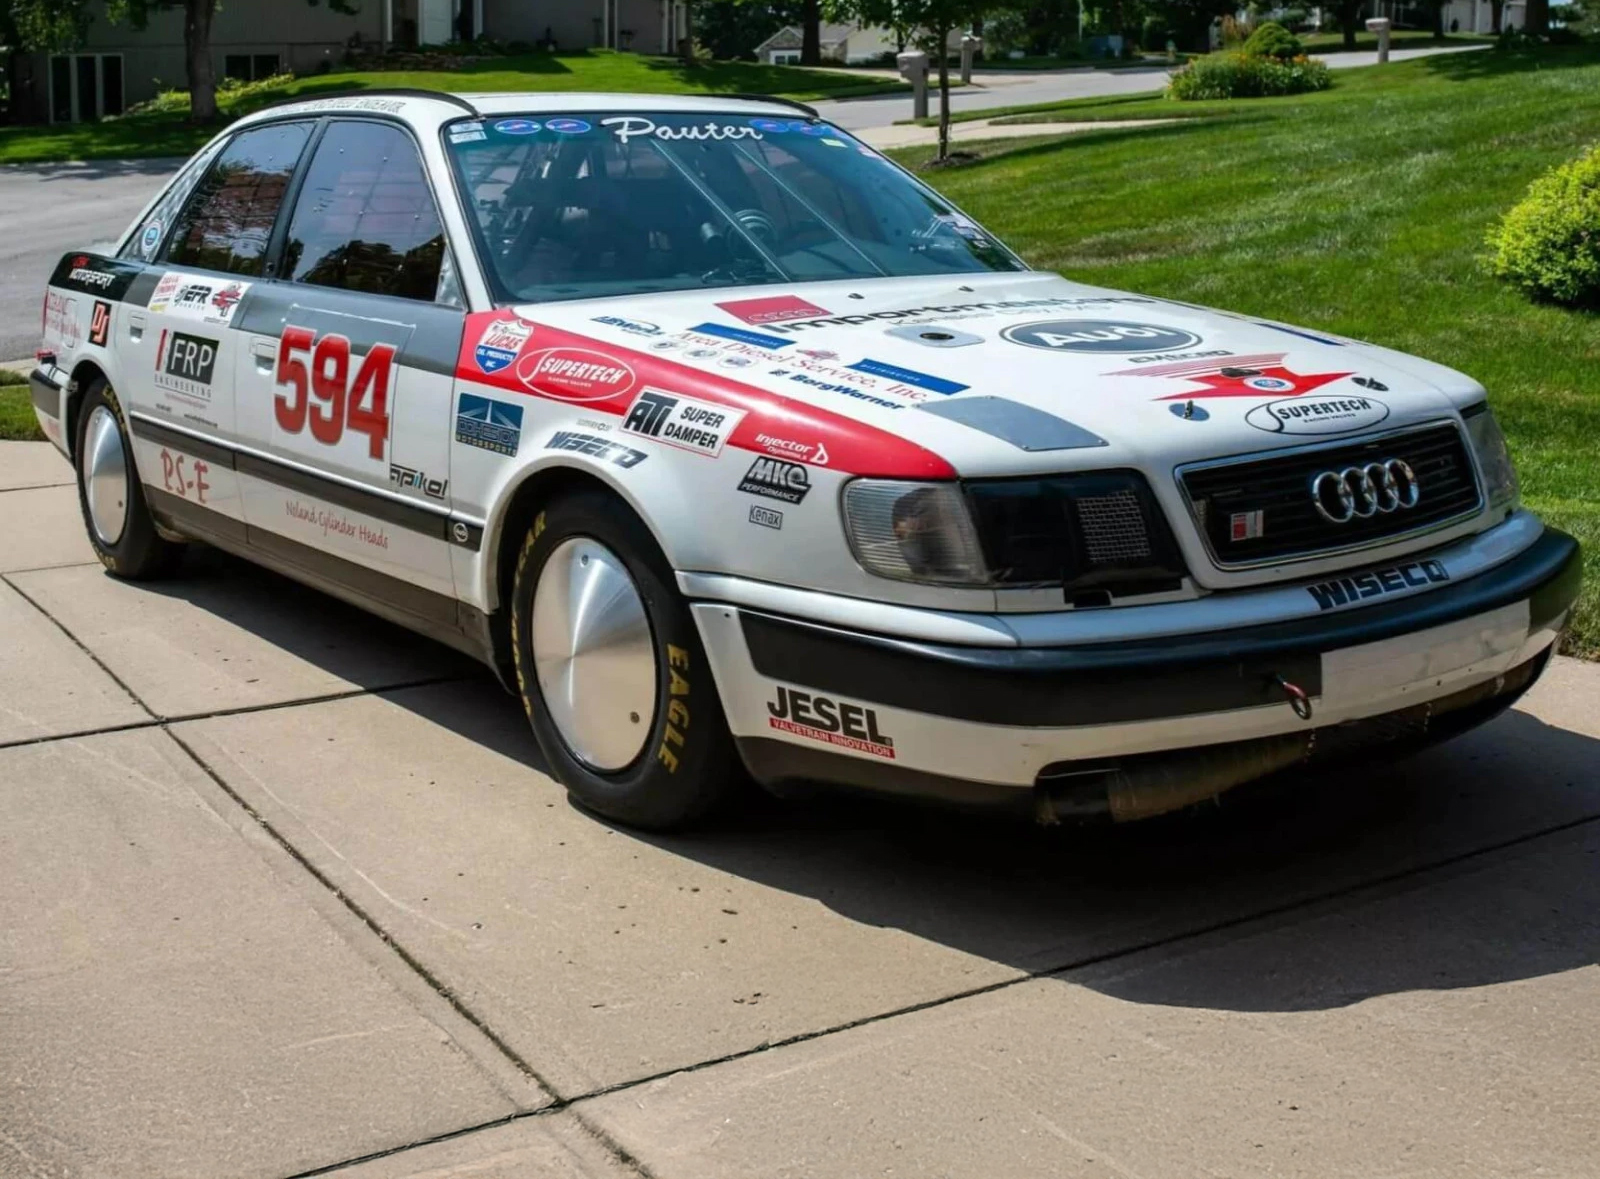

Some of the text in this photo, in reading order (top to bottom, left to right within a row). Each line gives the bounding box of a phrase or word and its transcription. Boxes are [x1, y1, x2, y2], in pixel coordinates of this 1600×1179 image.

[601, 116, 763, 144] Pauter
[170, 338, 213, 378] FRP
[483, 333, 523, 350] LUCAS
[486, 350, 515, 361] PRODUCTS
[540, 356, 628, 385] SUPERTECH
[671, 331, 720, 348] Area
[723, 341, 796, 363] Diesel
[792, 359, 877, 388] Service,
[885, 382, 928, 402] Inc.
[154, 373, 212, 399] ENGINEERING
[273, 324, 397, 461] 594
[789, 374, 906, 411] BorgWarner
[623, 391, 681, 437] ATI
[680, 405, 727, 429] SUPER
[1280, 398, 1373, 420] SUPERTECH
[663, 420, 720, 449] DAMPER
[755, 432, 815, 453] Injector
[390, 463, 448, 500] apikol
[741, 482, 800, 502] PERFORMANCE
[318, 510, 357, 537] Cylinder
[358, 523, 388, 549] Heads
[750, 503, 780, 526] Kenax
[1307, 559, 1450, 611] WISECO
[658, 642, 690, 774] EAGLE
[767, 685, 894, 748] JESEL
[773, 718, 893, 758] VALVETRAIN INNOVATION
